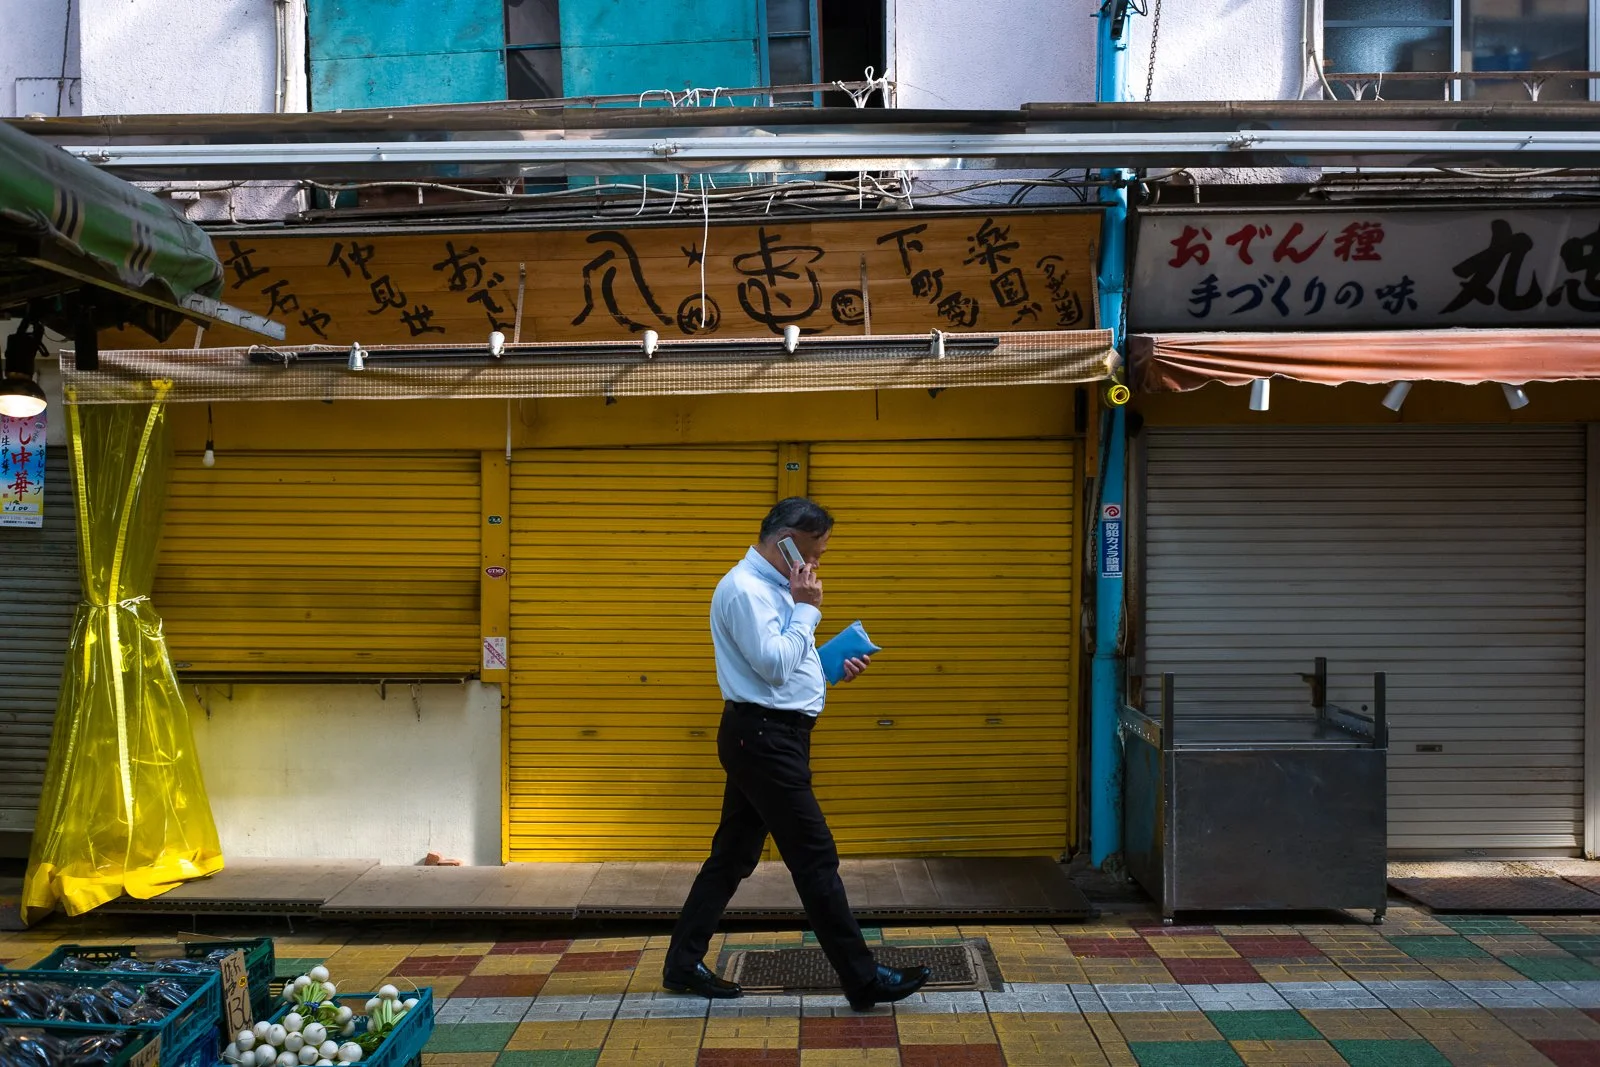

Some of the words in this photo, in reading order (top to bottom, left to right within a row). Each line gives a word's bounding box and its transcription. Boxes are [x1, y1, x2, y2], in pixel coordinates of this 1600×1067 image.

[1168, 221, 1385, 268] おでん種
[327, 241, 446, 337] 仲見世
[433, 241, 517, 332] おでん
[1187, 274, 1418, 318] 手づくりの味
